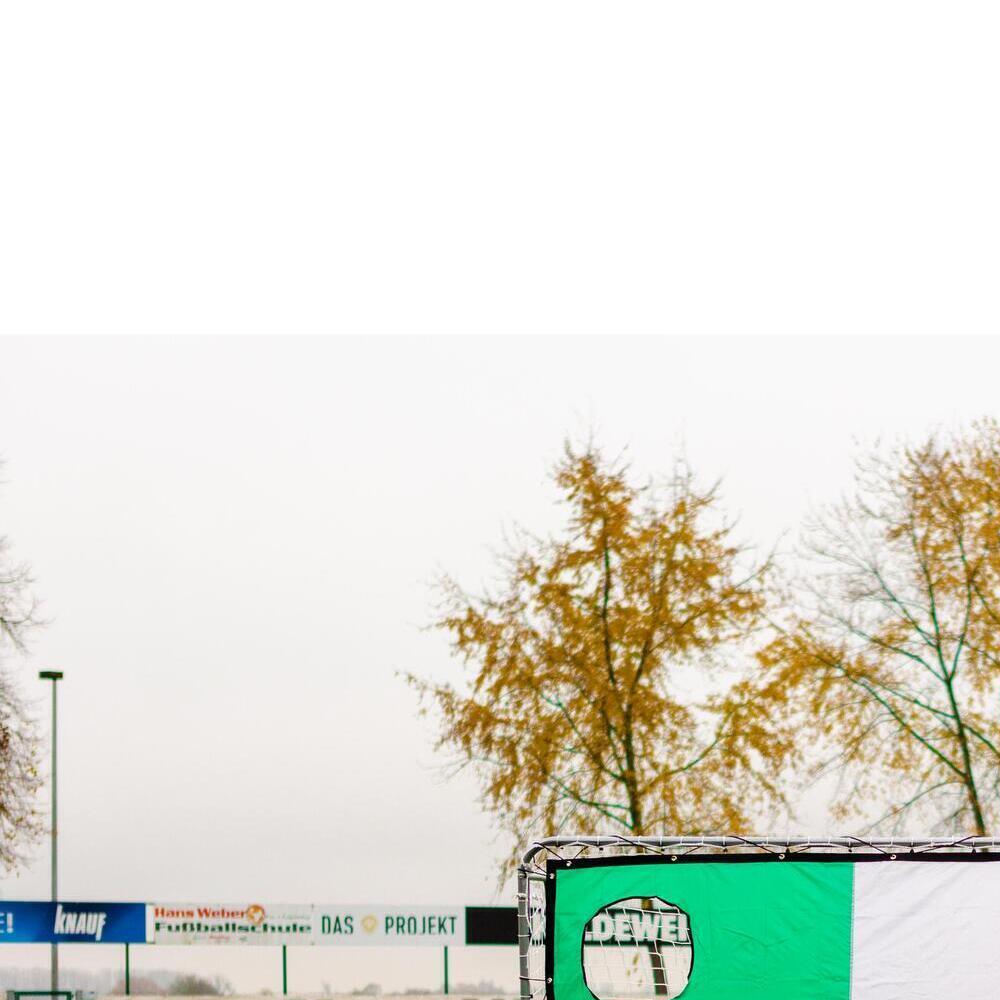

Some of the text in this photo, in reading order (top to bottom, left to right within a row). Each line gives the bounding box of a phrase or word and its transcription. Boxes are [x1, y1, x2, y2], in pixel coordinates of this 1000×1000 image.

[155, 907, 247, 918] Hans Weber
[322, 915, 458, 935] DAS PROJEKT
